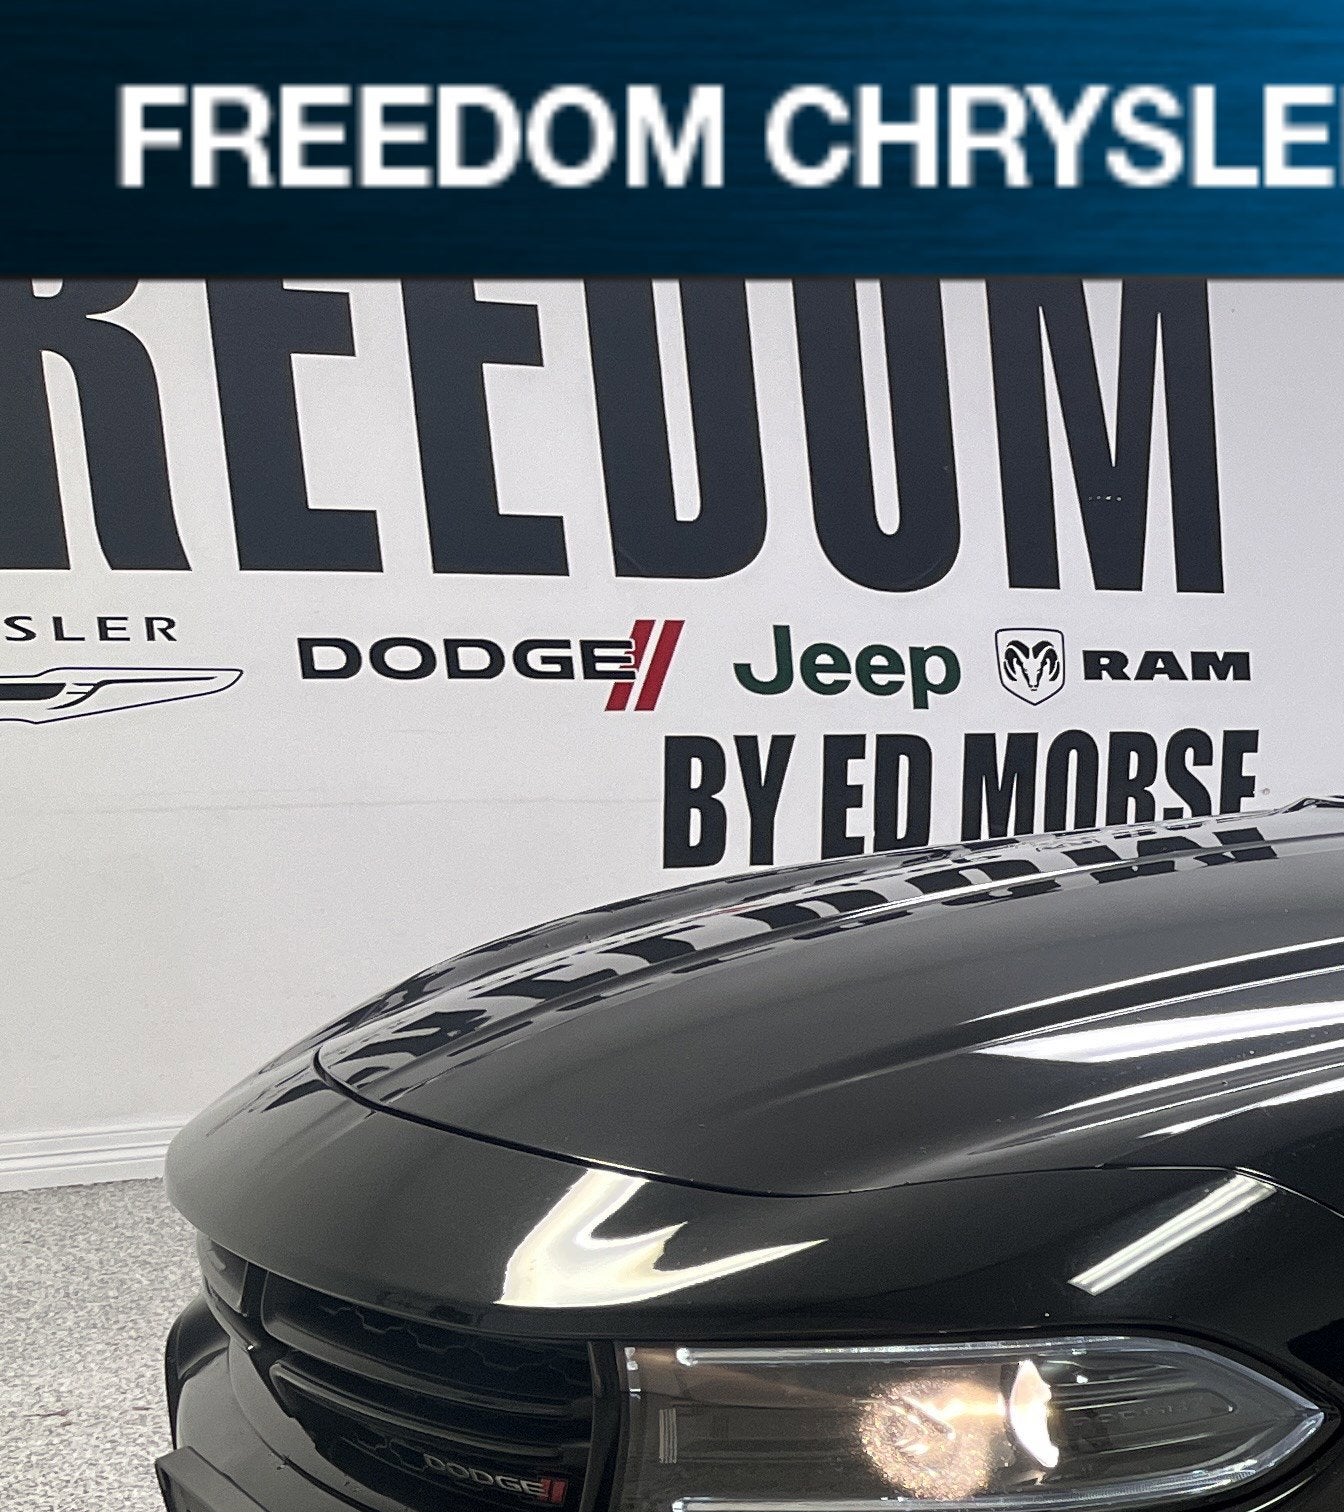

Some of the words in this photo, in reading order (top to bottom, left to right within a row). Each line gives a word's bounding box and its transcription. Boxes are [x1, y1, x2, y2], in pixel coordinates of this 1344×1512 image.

[297, 636, 637, 680] DODGE
[733, 624, 961, 710] Jeep
[1082, 649, 1251, 682] RAM
[663, 734, 796, 870] BY
[821, 733, 933, 860] ED
[961, 728, 1259, 842] MORSE
[423, 1453, 549, 1498] DODGE
